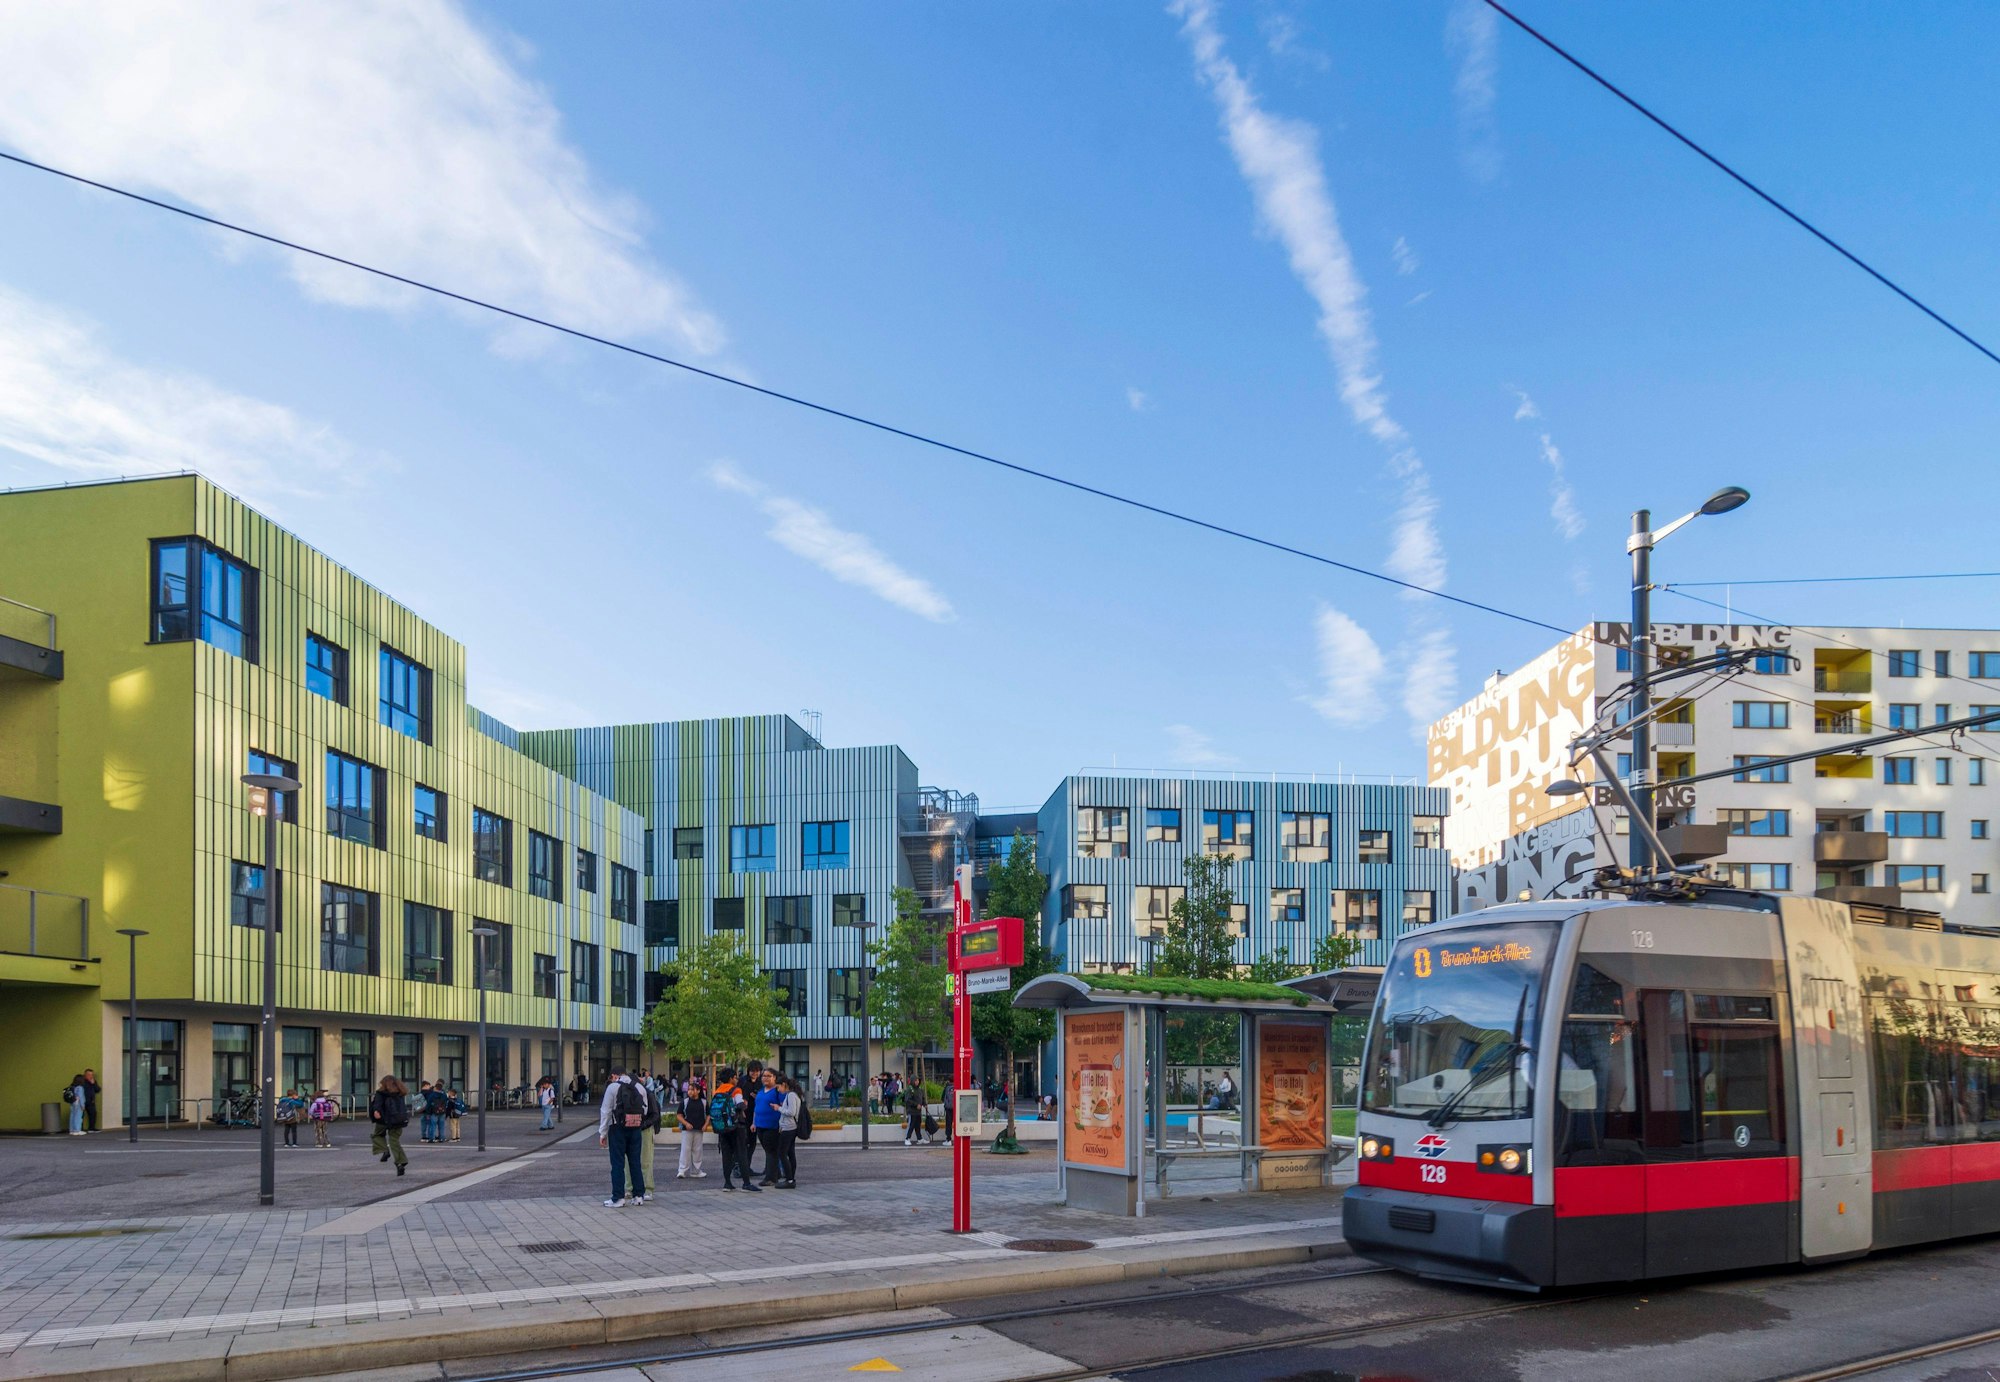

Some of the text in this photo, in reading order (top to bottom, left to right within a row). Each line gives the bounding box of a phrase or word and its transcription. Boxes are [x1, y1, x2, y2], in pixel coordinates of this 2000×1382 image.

[1428, 648, 1595, 788] BILDUNG
[1631, 930, 1654, 948] 128
[968, 975, 1008, 987] Bruno-Marek-Allee
[1082, 1072, 1109, 1090] Little Italy
[1275, 1076, 1304, 1091] Little Italy
[1420, 1163, 1447, 1184] 128
